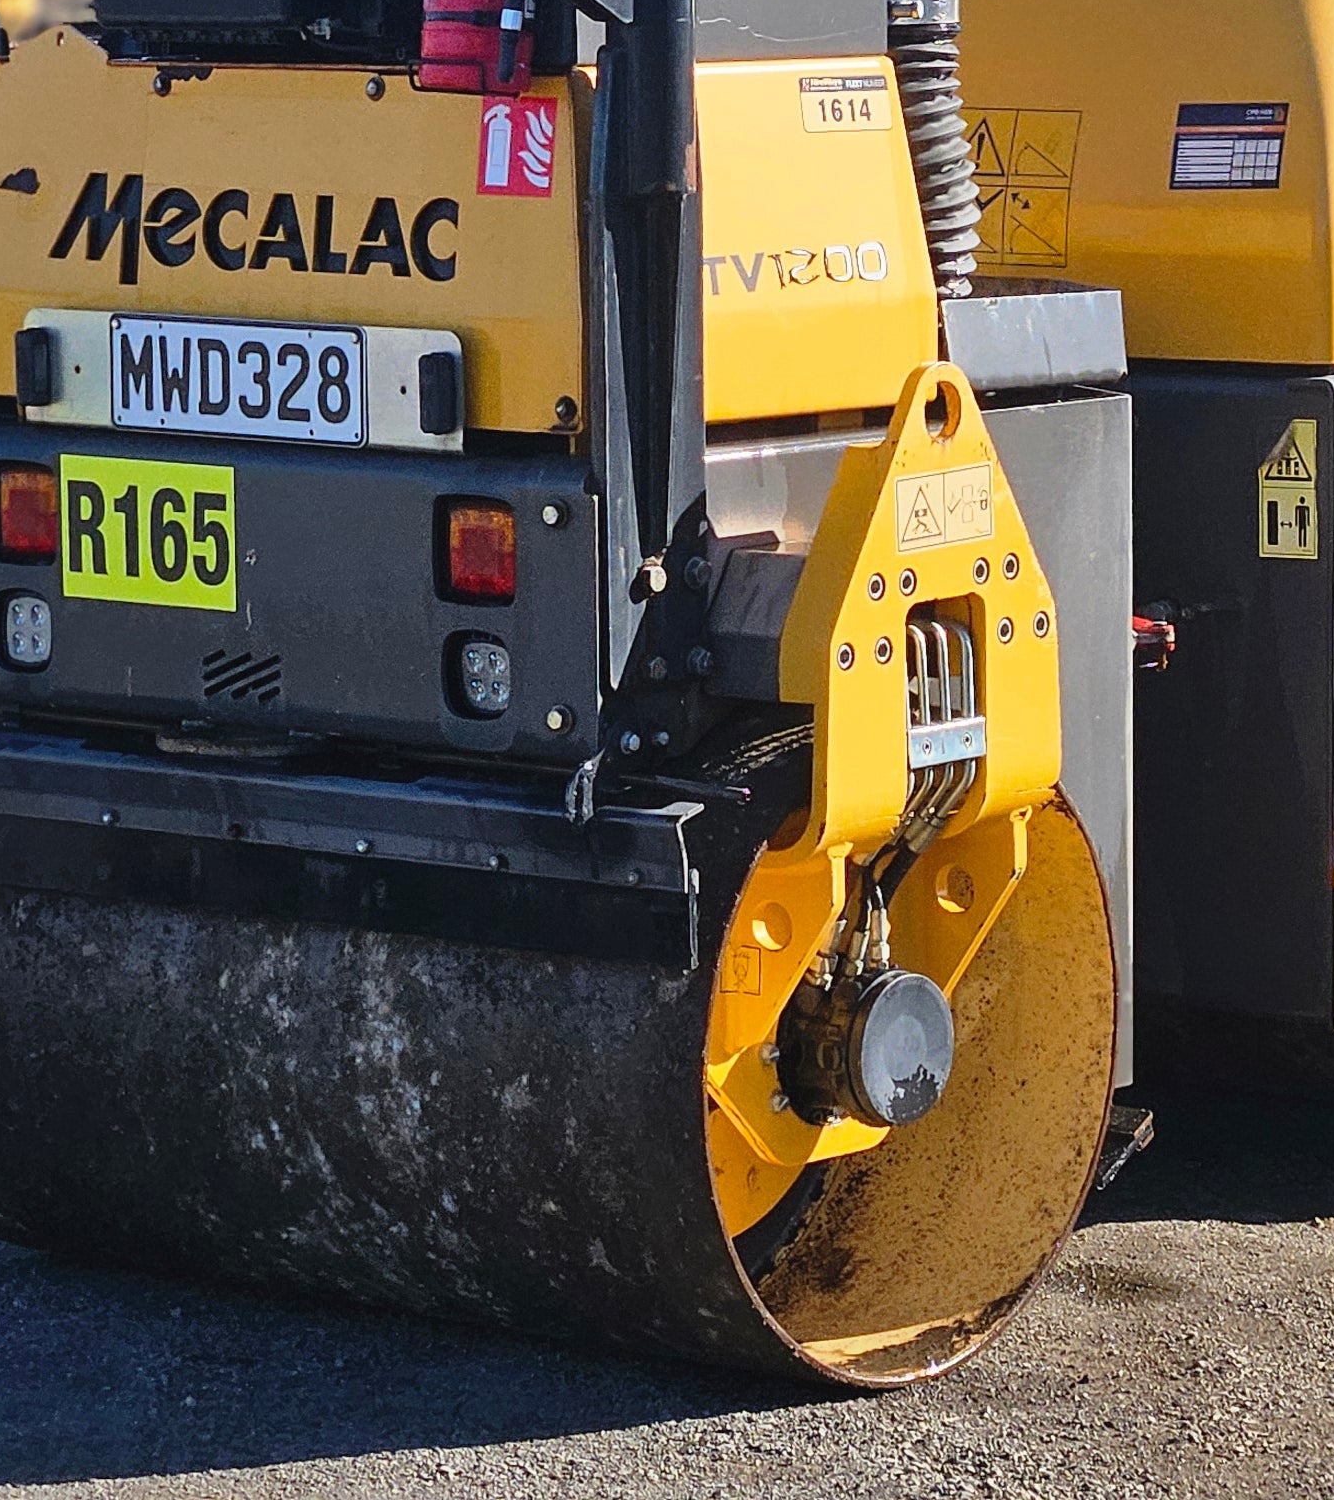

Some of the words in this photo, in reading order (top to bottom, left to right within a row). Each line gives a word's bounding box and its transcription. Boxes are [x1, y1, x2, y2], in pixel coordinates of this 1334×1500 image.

[818, 98, 871, 122] 1614
[703, 242, 888, 296] TV1200
[120, 332, 351, 424] MWD328
[67, 480, 229, 587] R165
